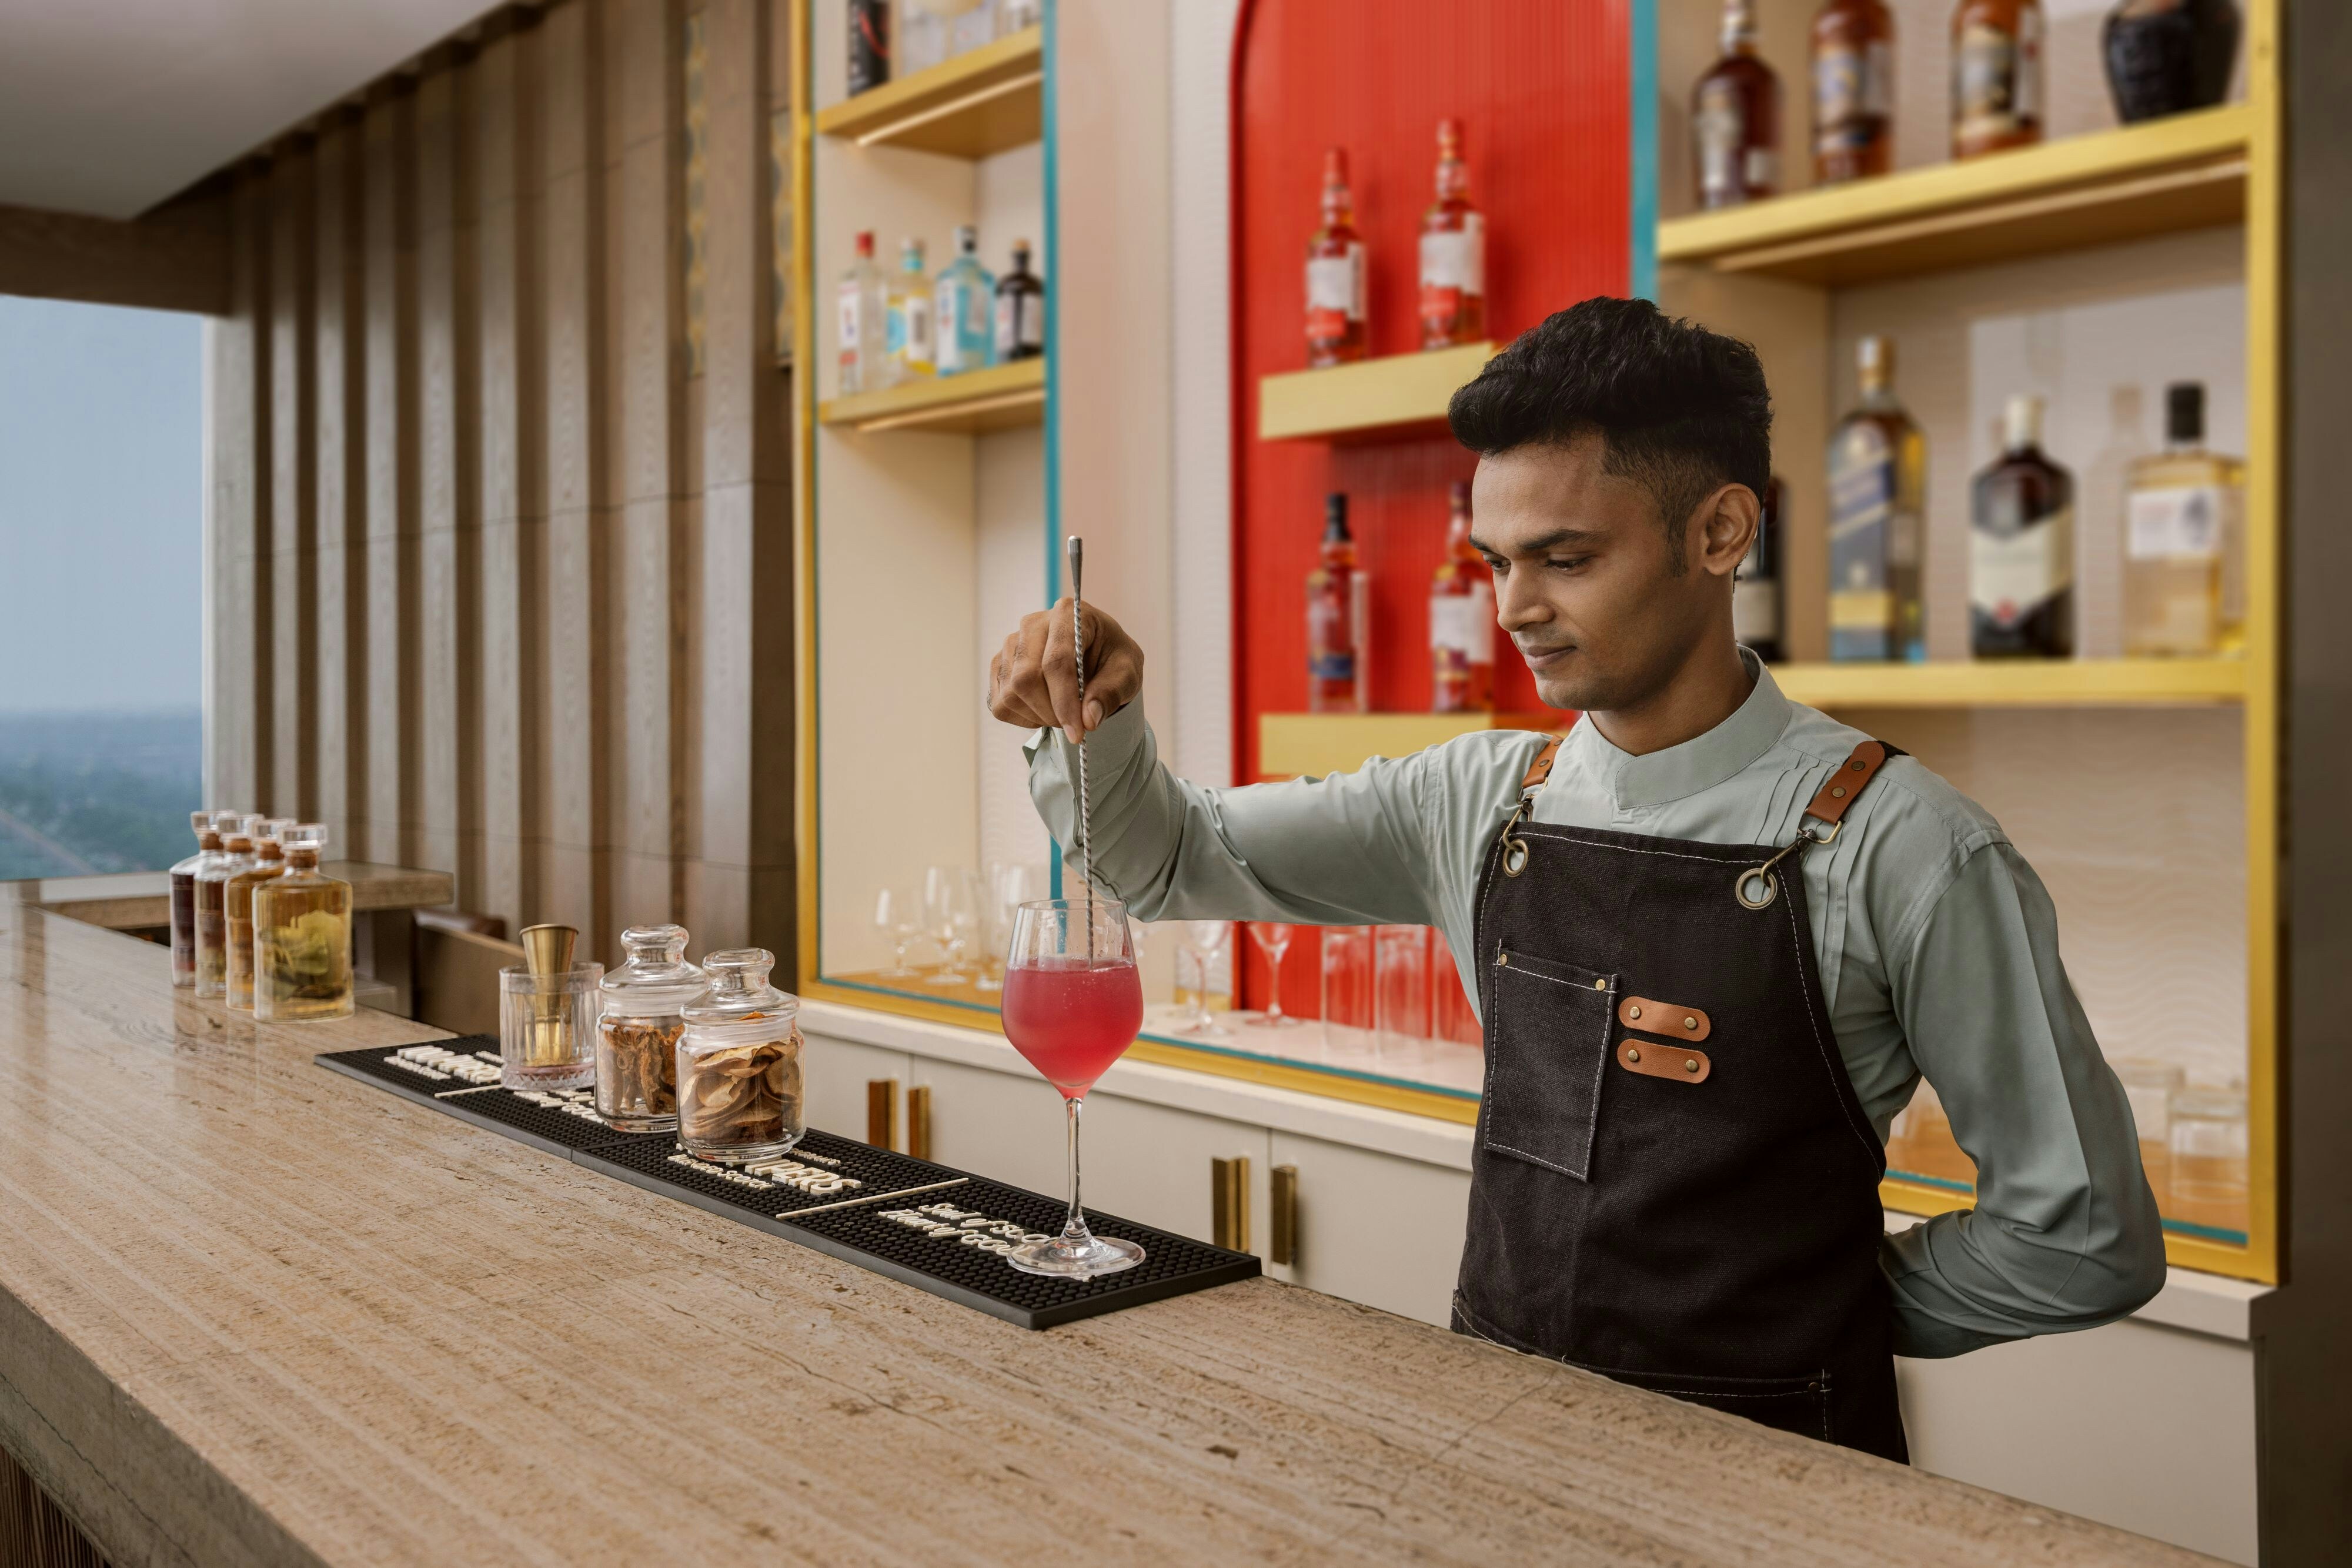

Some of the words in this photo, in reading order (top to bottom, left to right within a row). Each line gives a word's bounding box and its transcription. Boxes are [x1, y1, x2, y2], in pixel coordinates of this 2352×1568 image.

[667, 1154, 724, 1175] BLENDED
[717, 1170, 776, 1190] SCOTCH
[918, 1203, 981, 1221] Soul
[960, 1218, 1010, 1228] of
[928, 1227, 979, 1238] of
